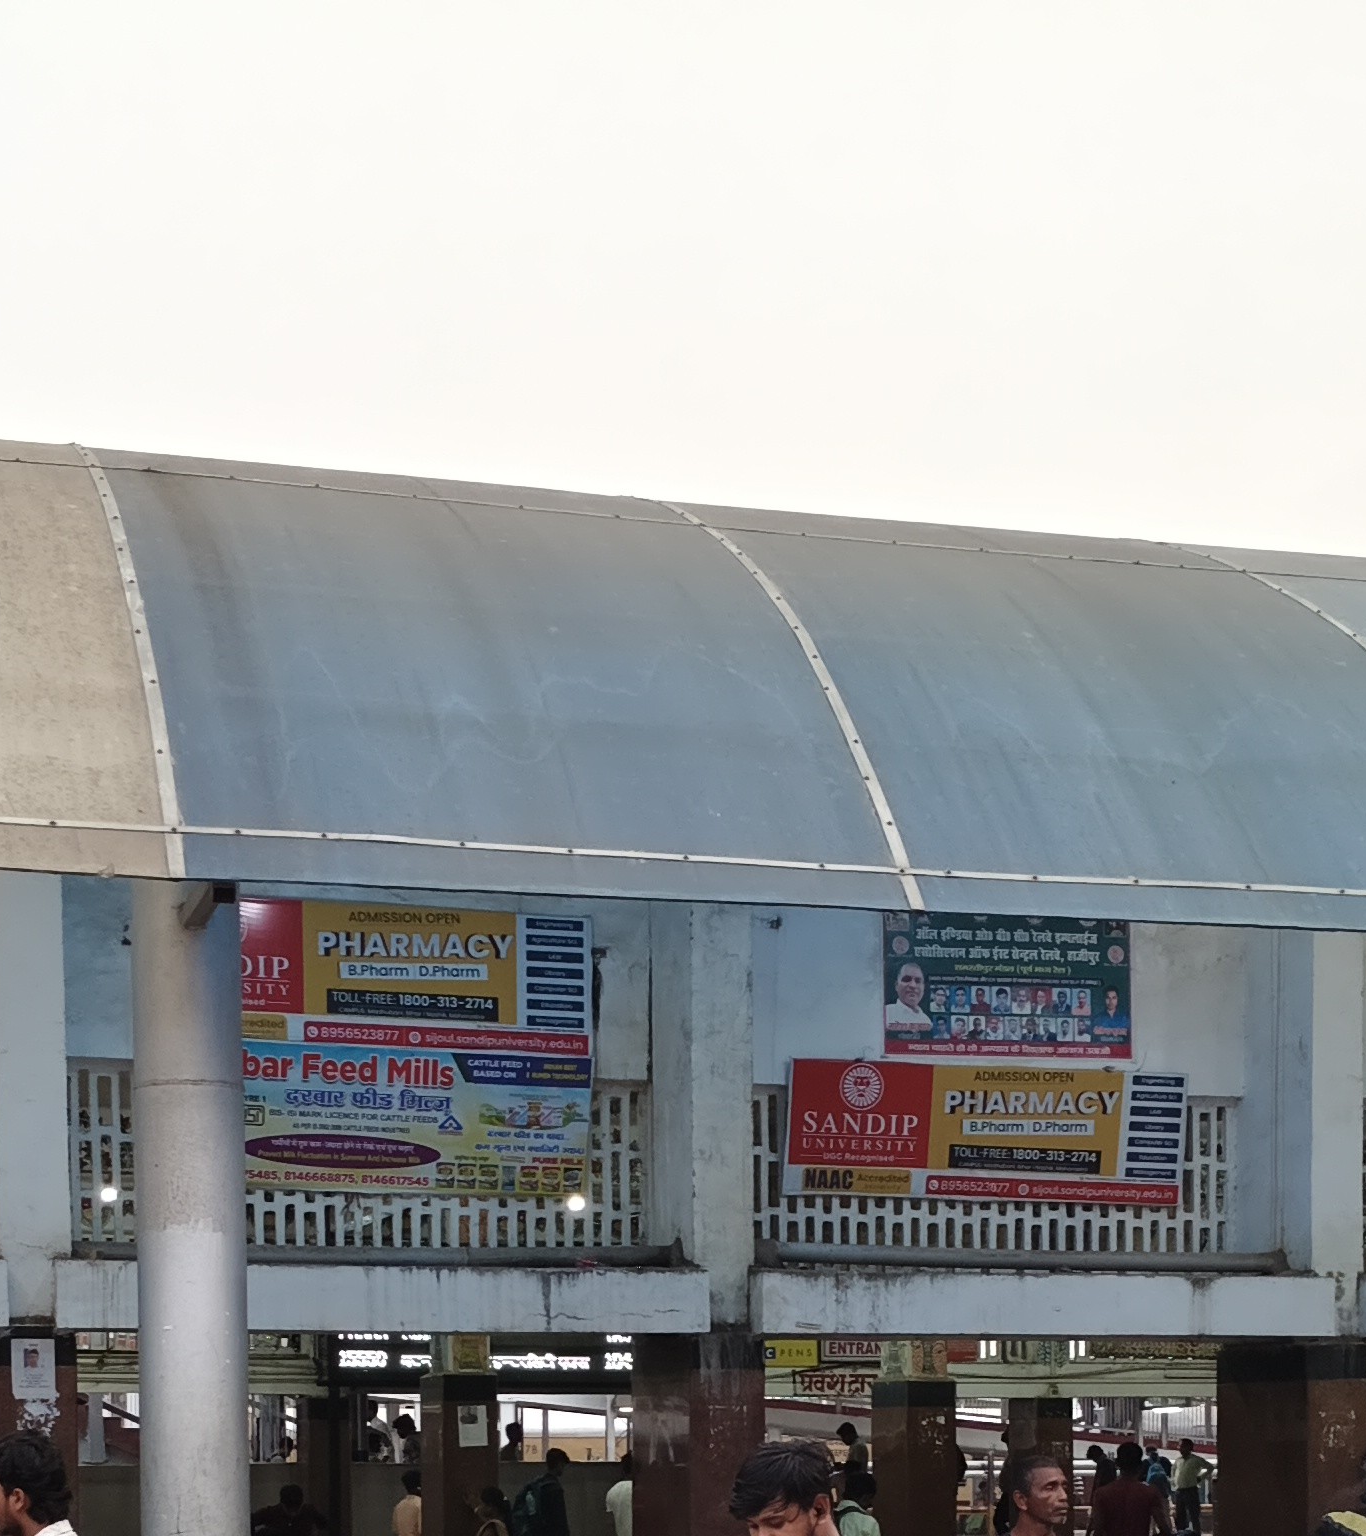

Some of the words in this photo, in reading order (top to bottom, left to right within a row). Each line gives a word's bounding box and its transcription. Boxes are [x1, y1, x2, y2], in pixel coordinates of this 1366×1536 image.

[348, 911, 423, 924] ADMISSION
[426, 913, 460, 924] OPEN
[317, 931, 513, 960] PHARMACY
[242, 955, 290, 979] DIP
[348, 964, 409, 977] B.Pharm
[419, 965, 480, 978] D.Pharm
[243, 983, 290, 996] SITY
[398, 993, 494, 1010] 1800-313-2714
[243, 1018, 285, 1029] redited
[320, 1026, 399, 1041] 8956523877
[242, 1048, 293, 1080] bar
[302, 1052, 378, 1085] Feed
[387, 1055, 454, 1088] Mills
[467, 1060, 499, 1068] CATTLE
[501, 1061, 523, 1069] FEED
[473, 1070, 501, 1078] BASED
[974, 1071, 1040, 1083] ADMISSION
[1043, 1072, 1074, 1083] OPEN
[285, 1088, 345, 1108] दरबार
[352, 1087, 393, 1110] फीड
[944, 1089, 1120, 1115] PHARMACY
[325, 1112, 361, 1120] LICENCE
[362, 1113, 379, 1121] FOR
[381, 1114, 410, 1122] CATTLE
[412, 1115, 439, 1123] FEEDS
[803, 1111, 918, 1136] SANDIP
[969, 1121, 1024, 1133] B.Pharm
[1033, 1122, 1088, 1133] D.Pharm
[802, 1138, 916, 1152] UNIVERSITY
[1012, 1149, 1097, 1162] 1800-313-2714
[245, 1170, 281, 1182] 5485,
[805, 1168, 853, 1190] NAAC
[780, 1348, 813, 1357] PENS
[829, 1341, 882, 1355] ENTRAN
